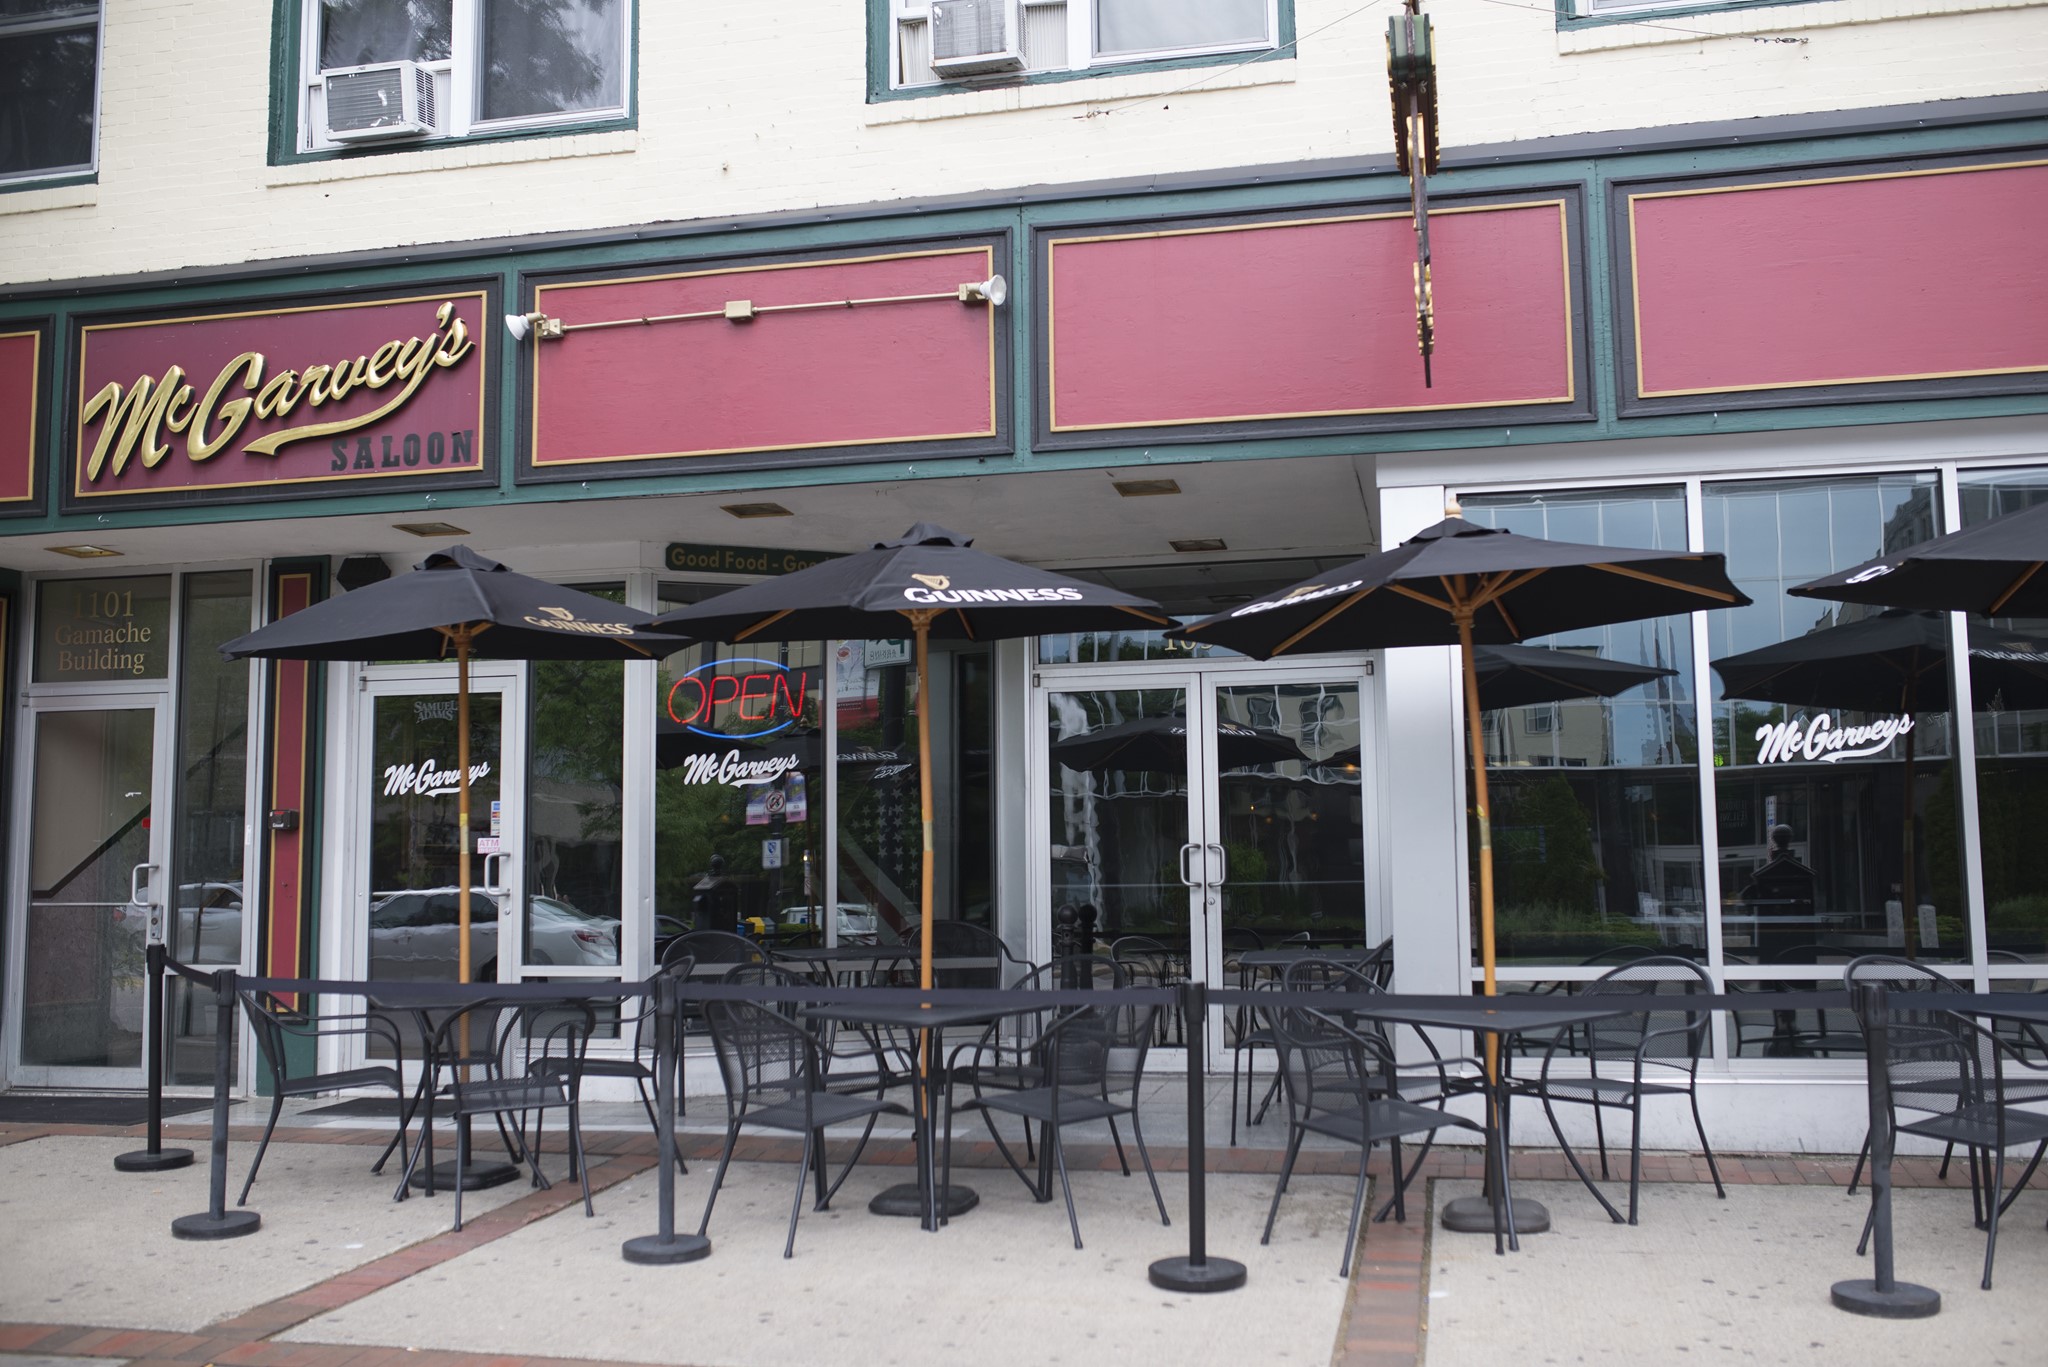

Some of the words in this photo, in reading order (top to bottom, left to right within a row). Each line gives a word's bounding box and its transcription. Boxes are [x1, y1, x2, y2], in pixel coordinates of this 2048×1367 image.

[83, 302, 476, 482] McGarvey's
[331, 430, 474, 471] SALOON
[671, 547, 720, 568] Good
[725, 551, 768, 571] Food
[73, 590, 134, 619] 1101
[904, 587, 1083, 603] GUINNESS
[55, 621, 151, 646] Gamache
[523, 615, 634, 635] GUINNESS
[58, 647, 145, 675] Building
[413, 699, 458, 714] SAMUEL
[667, 671, 807, 724] OPEN
[415, 709, 453, 725] ADAMS
[1755, 713, 1915, 765] McGarveys
[683, 749, 800, 788] McGarveys
[479, 839, 500, 847] ATM
